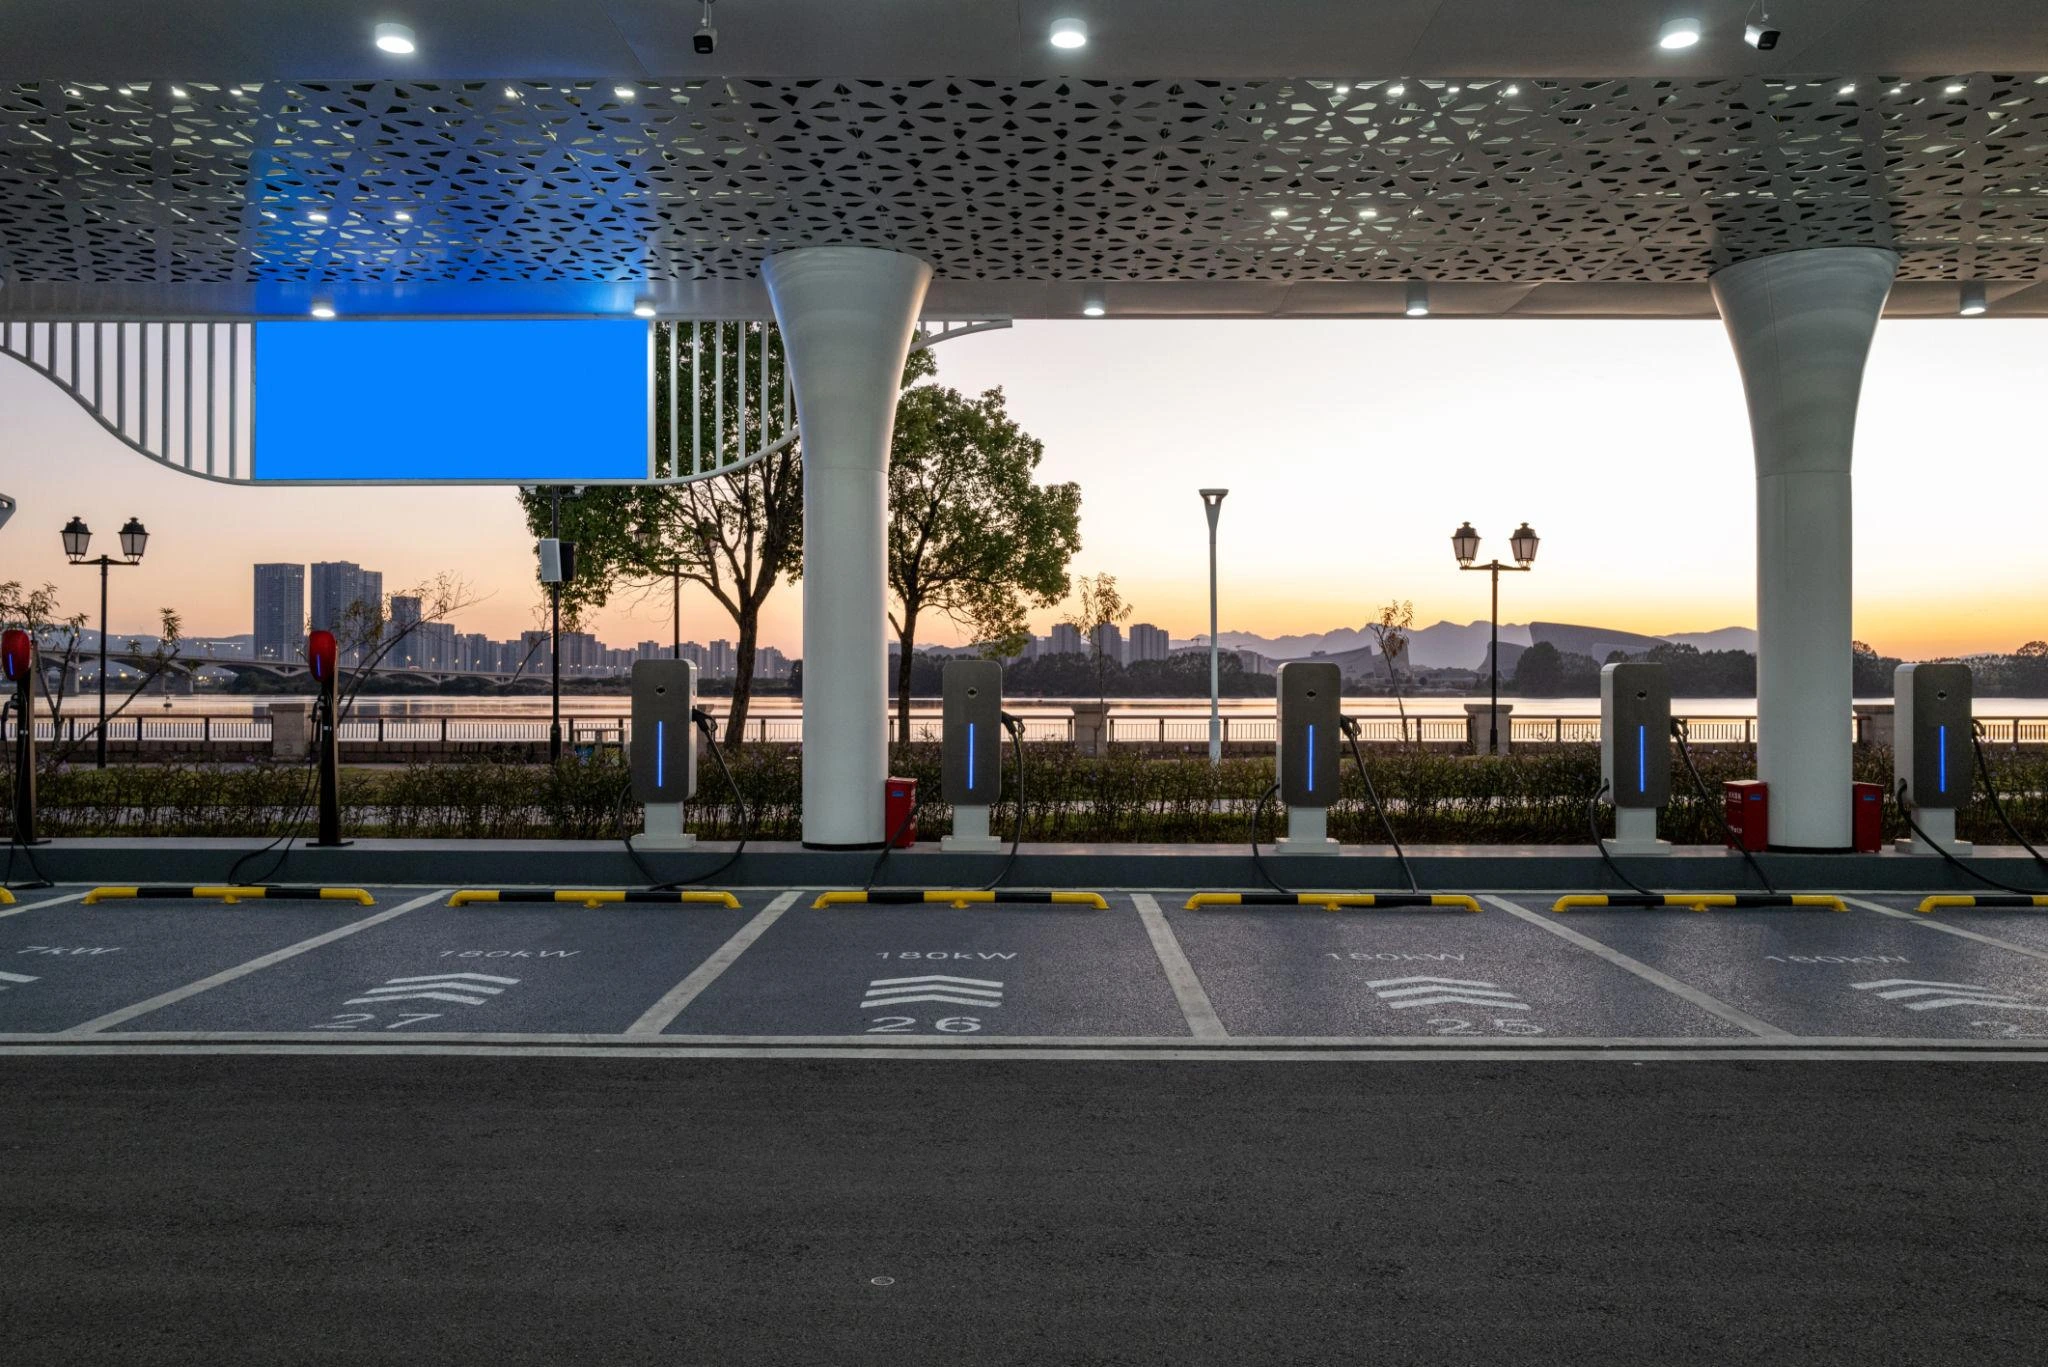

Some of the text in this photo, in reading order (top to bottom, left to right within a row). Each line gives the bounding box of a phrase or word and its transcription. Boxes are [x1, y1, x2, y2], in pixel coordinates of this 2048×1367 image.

[16, 945, 121, 956] 7kW
[438, 949, 583, 959] 180kW
[875, 951, 1018, 960] 180kW
[1324, 952, 1465, 961] 180kW
[309, 1012, 442, 1029] 27
[864, 1015, 982, 1033] 26
[1426, 1018, 1546, 1035] 25
